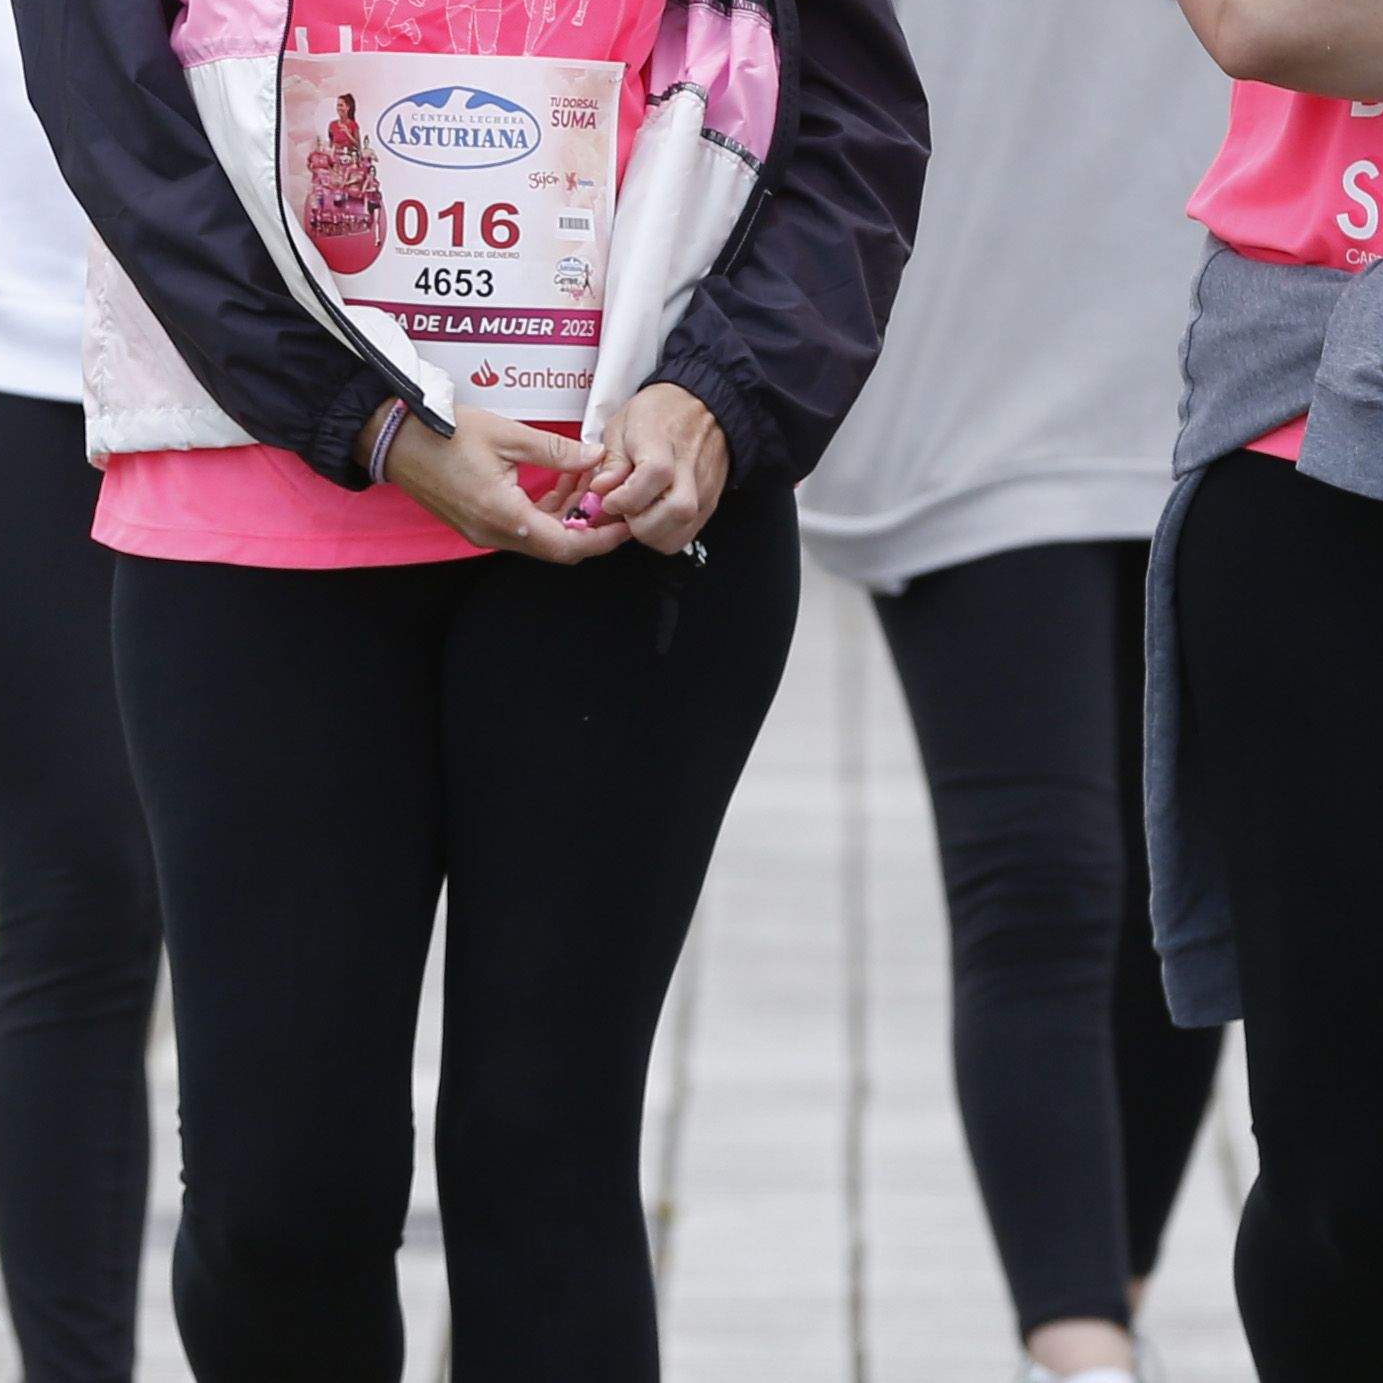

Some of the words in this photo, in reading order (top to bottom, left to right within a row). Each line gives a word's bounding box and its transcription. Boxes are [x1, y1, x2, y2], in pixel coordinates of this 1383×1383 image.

[550, 96, 562, 107] TU
[562, 97, 599, 110] DORSAL
[411, 113, 464, 123] CENTRAL
[469, 115, 525, 125] LECHERA
[550, 109, 597, 129] SUMA
[388, 113, 530, 149] ASTURIANA
[395, 199, 521, 249] 016
[415, 268, 494, 298] 4653
[413, 314, 441, 332] DE
[445, 315, 474, 334] LA
[479, 316, 555, 336] MUJER
[560, 319, 595, 337] 2023
